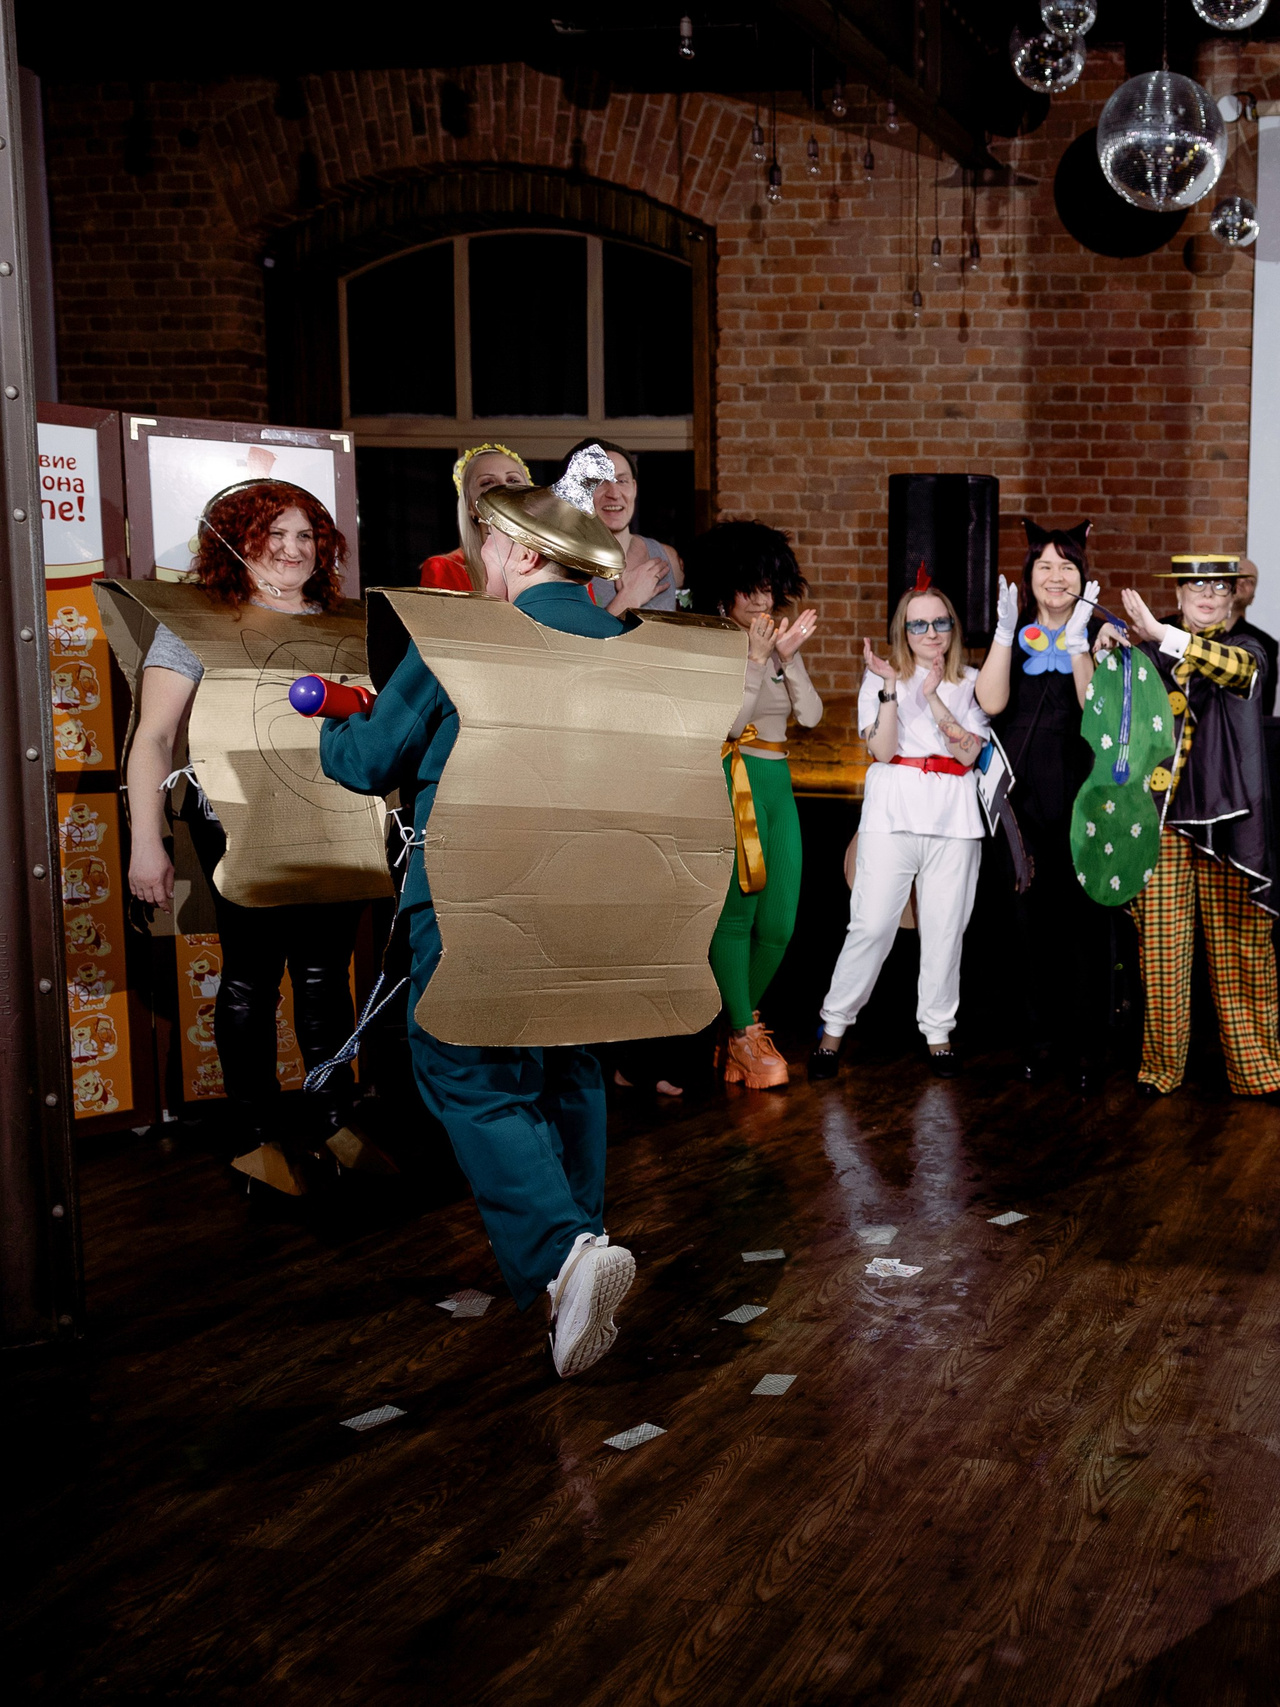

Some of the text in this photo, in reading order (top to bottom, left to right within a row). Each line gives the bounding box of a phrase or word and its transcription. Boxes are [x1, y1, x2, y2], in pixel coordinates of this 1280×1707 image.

[38, 454, 77, 470] вие
[42, 475, 85, 493] она
[41, 495, 86, 523] пе!
